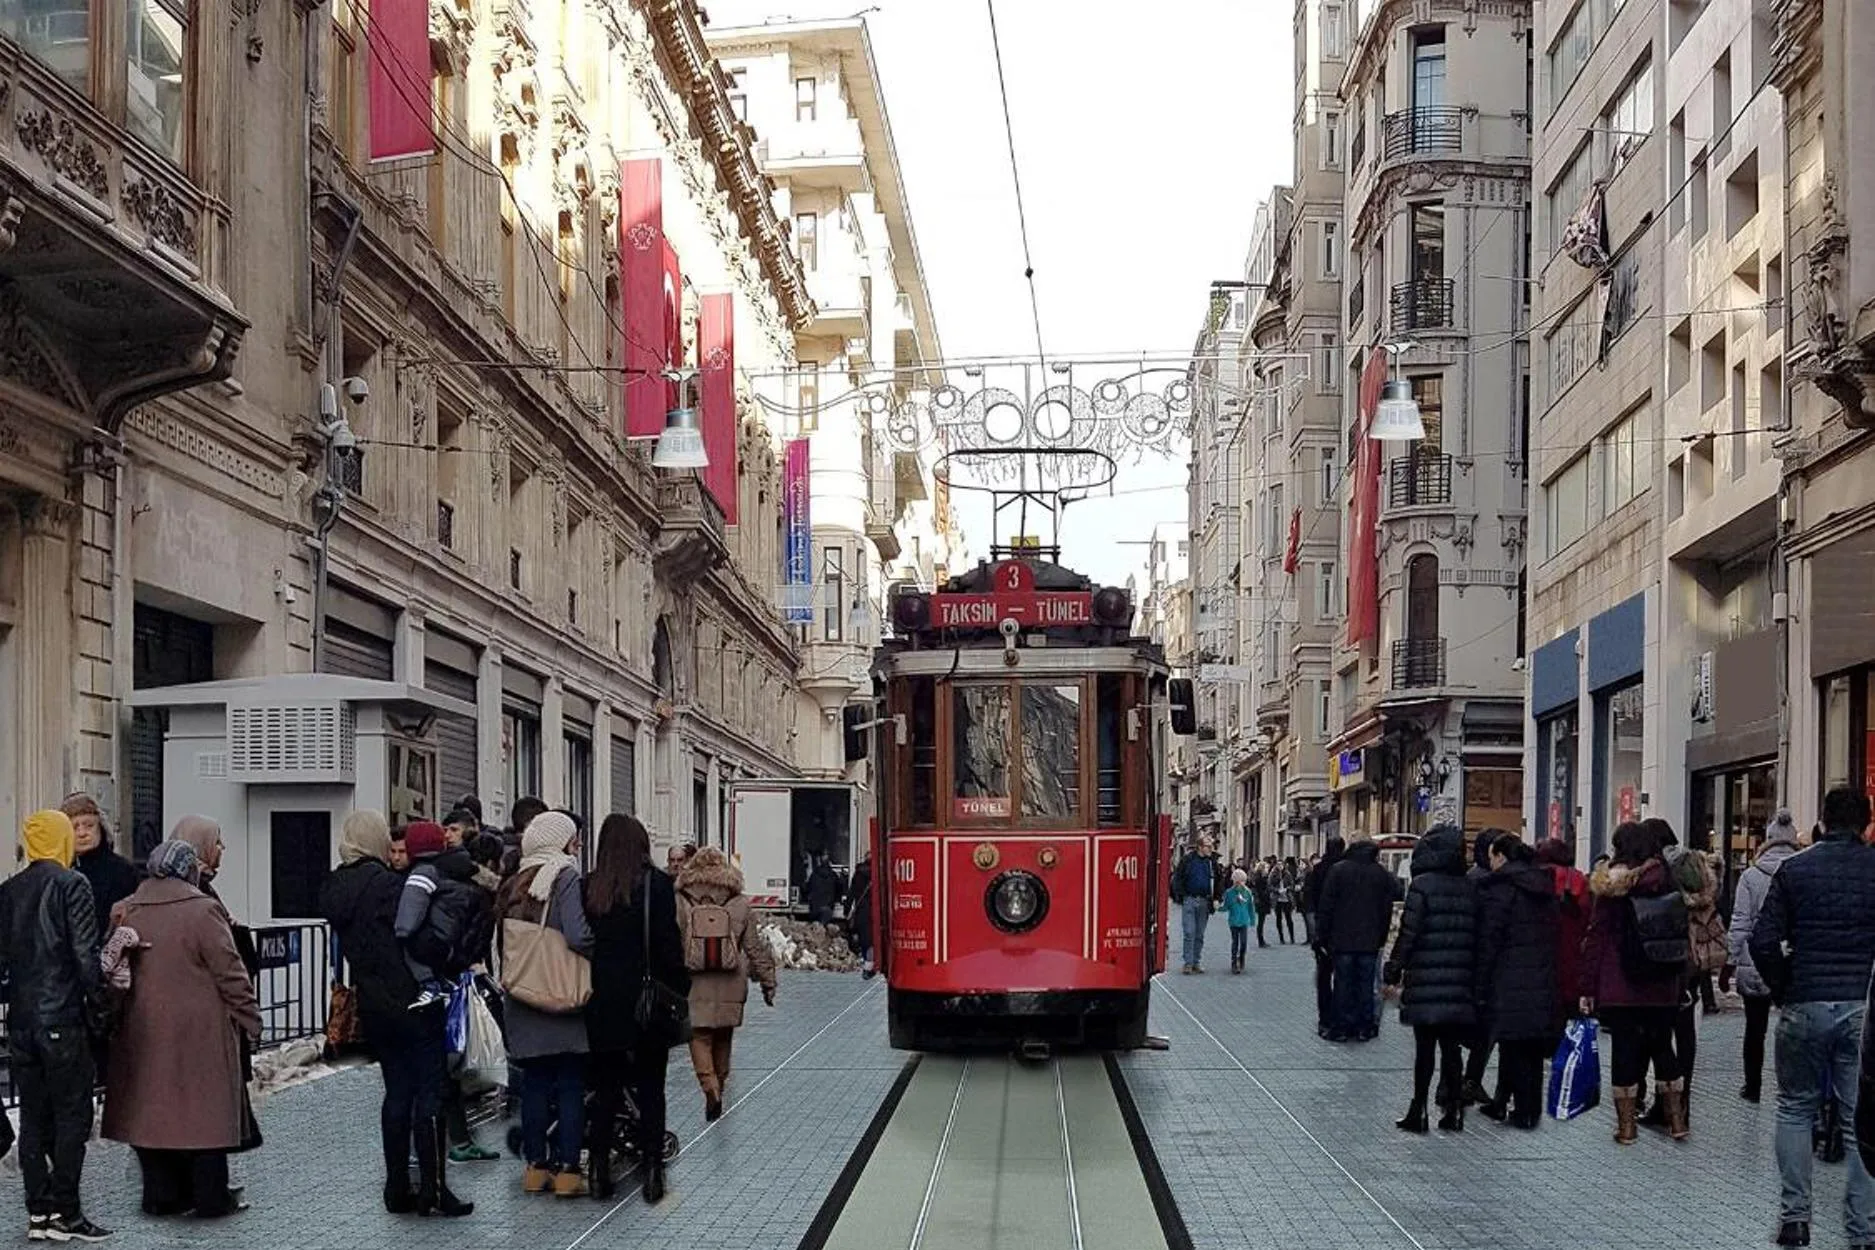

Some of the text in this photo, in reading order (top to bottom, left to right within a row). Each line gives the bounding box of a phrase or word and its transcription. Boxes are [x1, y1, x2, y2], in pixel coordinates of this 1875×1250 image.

[1007, 565, 1019, 589] 3
[1037, 598, 1089, 622] TÜNEL
[962, 800, 1004, 813] TÜNEL
[1114, 856, 1137, 880] 410
